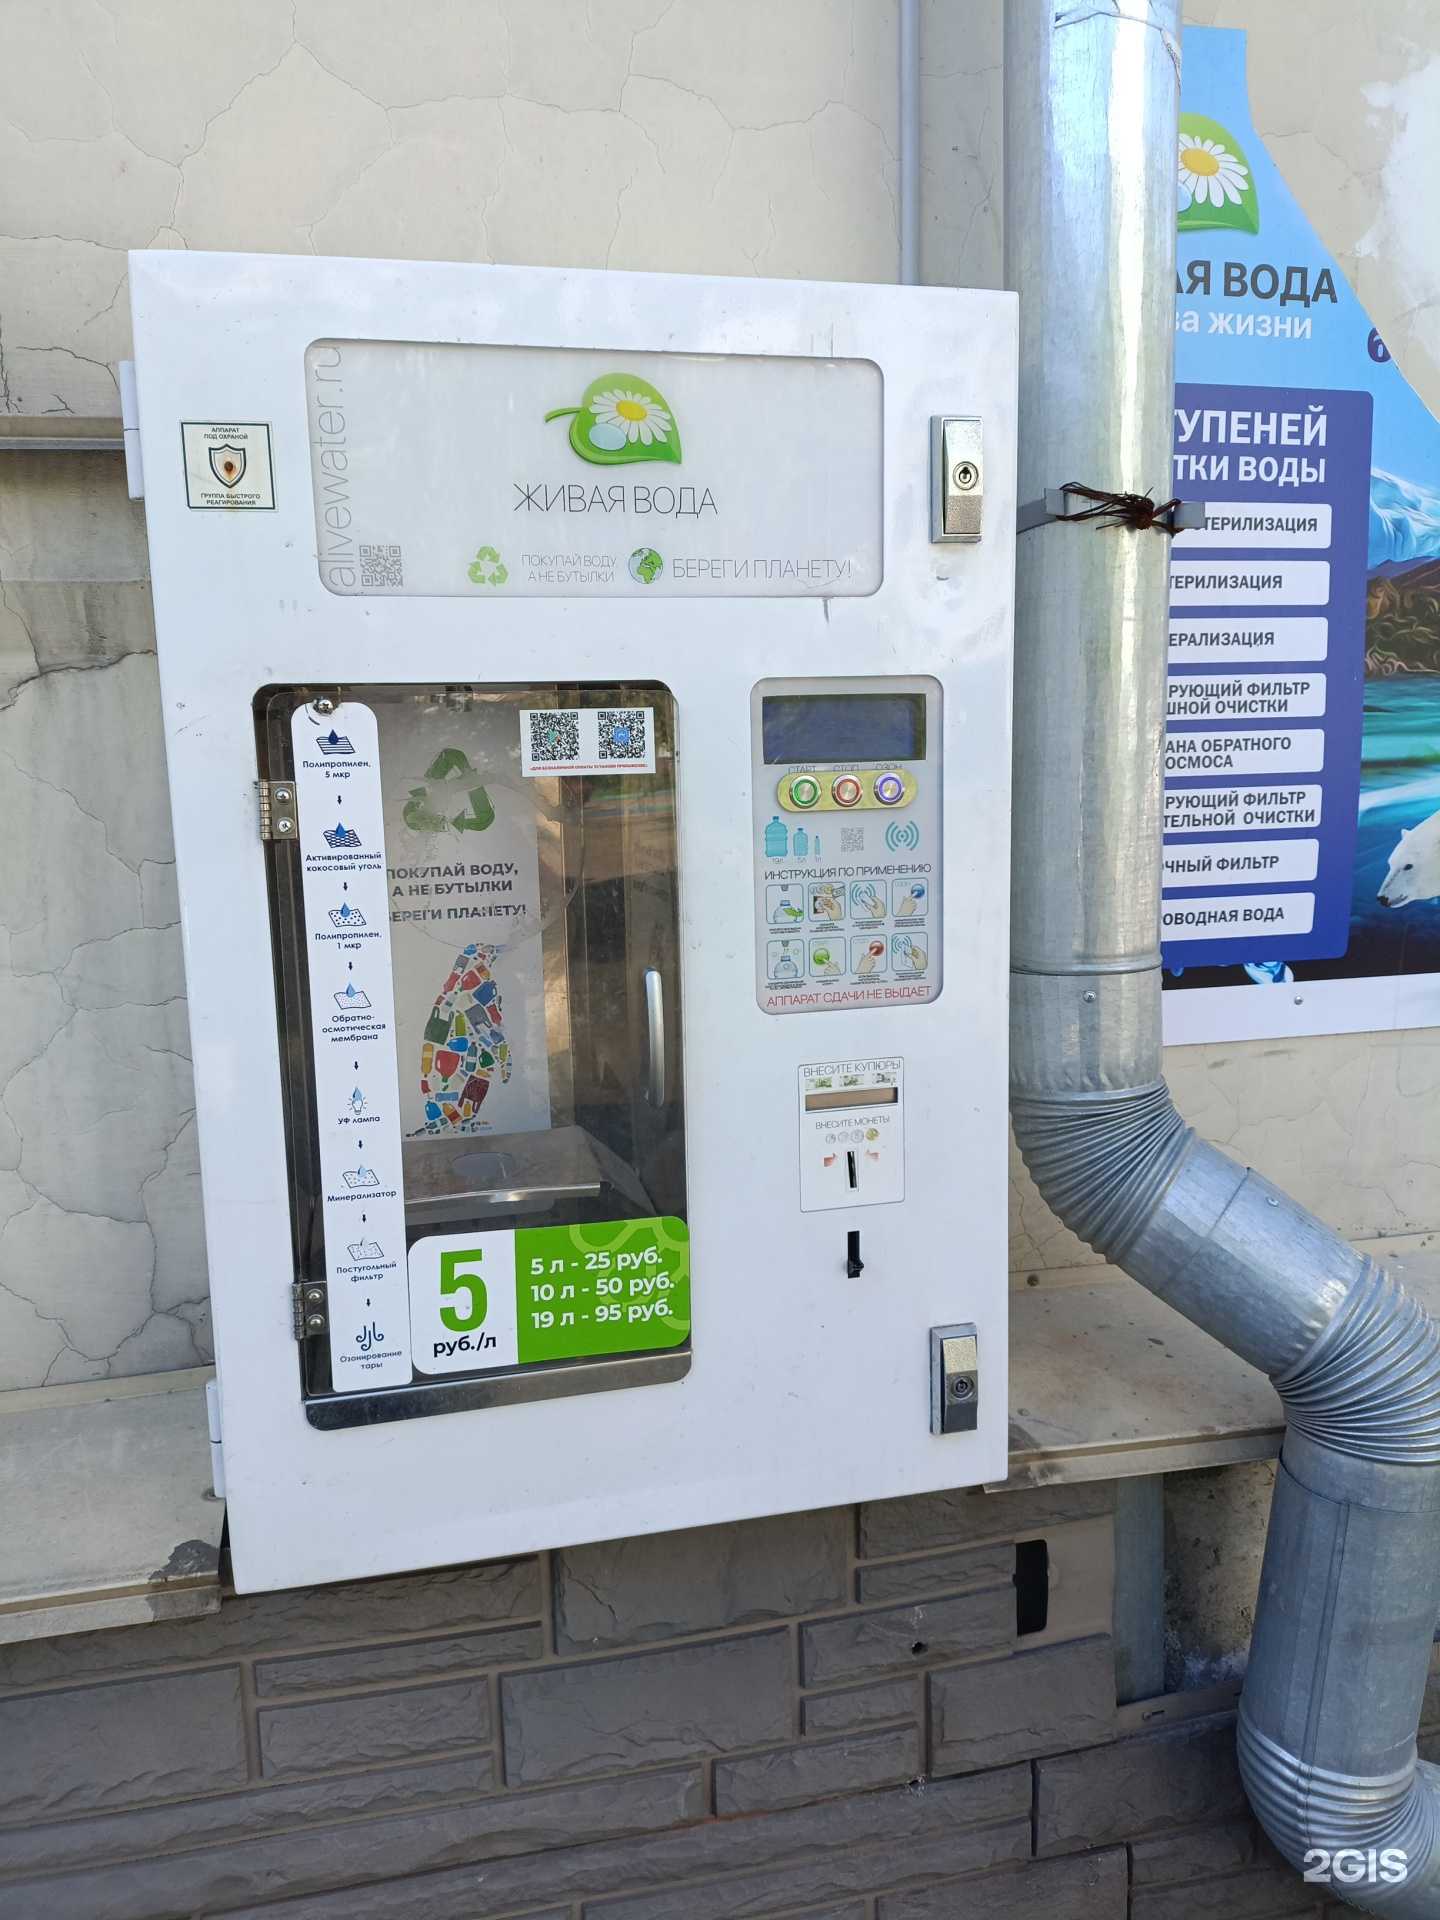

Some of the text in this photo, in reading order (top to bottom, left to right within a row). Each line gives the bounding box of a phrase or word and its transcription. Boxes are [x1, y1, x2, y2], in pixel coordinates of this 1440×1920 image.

[1223, 261, 1338, 307] ВОДА
[1208, 311, 1312, 339] жизни
[1175, 405, 1327, 446] УПЕНЕЙ
[311, 346, 356, 587] alivewater.ru
[1238, 456, 1326, 487] ВОДЫ
[513, 483, 719, 519] ЖИВАЯ ВОДА
[1204, 517, 1317, 532] ТЕРИЛИЗАЦИЯ
[521, 553, 581, 568] ПОКУПАЙ
[673, 558, 852, 580] БЕРЕГИ ПЛАНЕТУ!
[528, 571, 615, 583] А НЕ БУТЫЛКИ
[1246, 681, 1310, 696] ФИЛЬТР
[1215, 699, 1288, 715] ОЧИСТКИ
[1201, 737, 1291, 752] ОБРАТНОГО
[1165, 755, 1233, 770] ОСМОСА
[332, 771, 351, 779] мкр
[1243, 791, 1306, 806] ФИЛЬТР
[1243, 809, 1315, 825] ОЧИСТКИ
[305, 852, 382, 862] Активированный
[1162, 855, 1279, 874] ЧНЫЙ ФИЛЬТР
[306, 862, 382, 872] кокосовый уголь
[470, 863, 518, 876] ВОДУ,
[765, 864, 931, 880] ИНСТРУКЦИЯ ПО ПРИМЕНЕНИЮ
[392, 880, 512, 897] А НЕ БУТЫЛКИ
[389, 904, 526, 922] ЕРЕГИ ПЛАНЕТУ!
[1243, 907, 1284, 923] ВОДА
[766, 986, 931, 1007] АППАРАТ СДАЧИ НЕ ВЫДАЕТ
[332, 1014, 375, 1023] Обратно-
[322, 1024, 386, 1033] осмотическая
[331, 1034, 378, 1042] мембрана
[803, 1060, 900, 1077] ВНЕСИТЕ КУПЮРЫ
[352, 1116, 381, 1124] лампа
[815, 1115, 890, 1129] ВНЕСИТЕ МОНЕТЫ
[327, 1190, 397, 1202] Минерализатор
[531, 1258, 544, 1275] 5
[550, 1259, 564, 1273] л
[584, 1252, 610, 1270] 25
[616, 1245, 662, 1271] руб.
[336, 1262, 397, 1274] Постугольный
[351, 1273, 384, 1283] фильтр
[439, 1248, 488, 1332] 5
[531, 1284, 555, 1301] 10
[560, 1285, 575, 1299] л
[595, 1278, 623, 1296] 50
[629, 1271, 674, 1296] руб.
[531, 1310, 554, 1328] 19
[560, 1311, 574, 1325] л
[595, 1304, 622, 1322] 95
[628, 1298, 673, 1323] руб.
[433, 1332, 497, 1357] руб./л
[339, 1350, 402, 1363] Озонирование
[360, 1362, 383, 1370] тары
